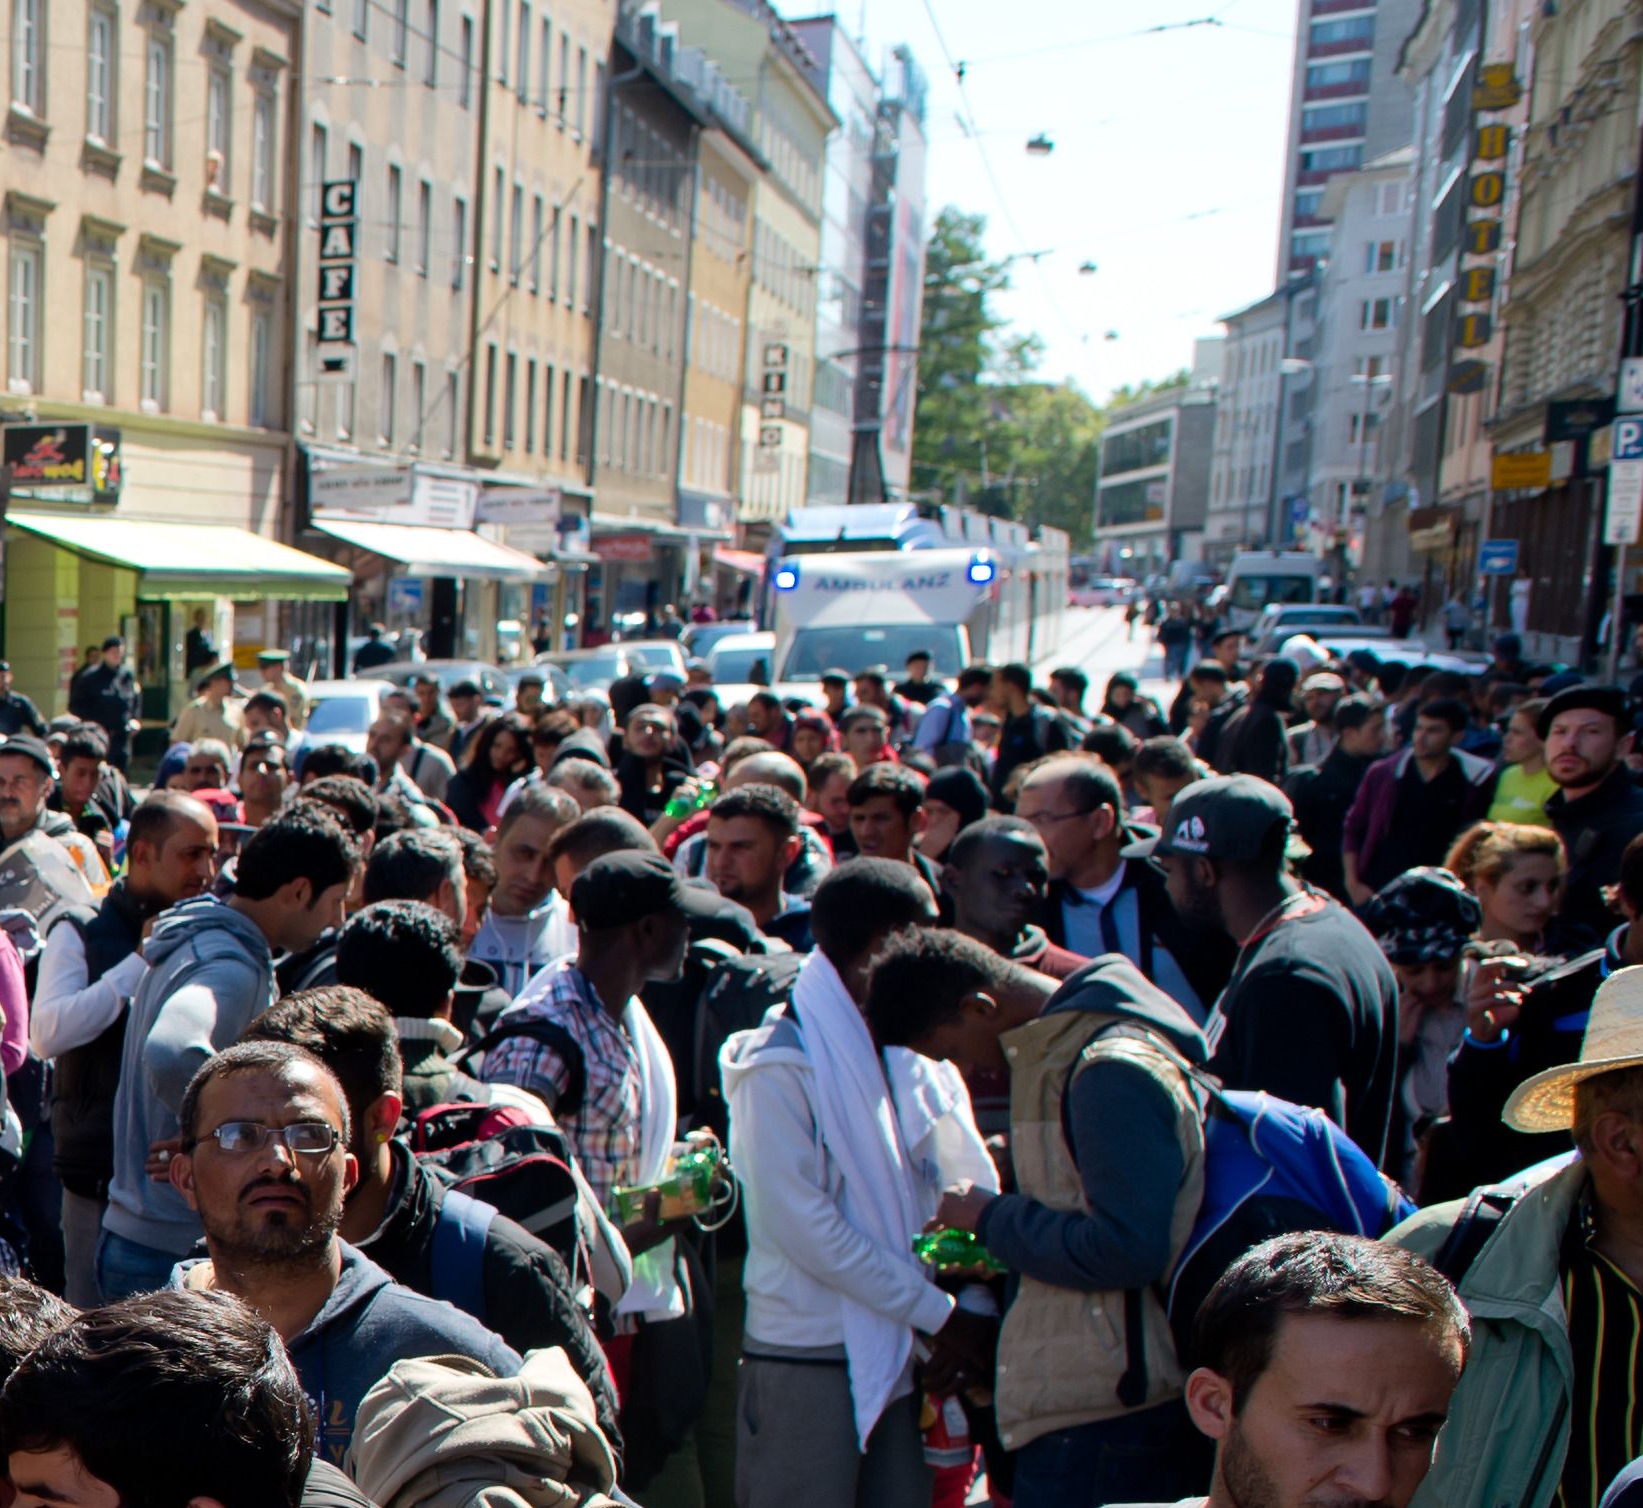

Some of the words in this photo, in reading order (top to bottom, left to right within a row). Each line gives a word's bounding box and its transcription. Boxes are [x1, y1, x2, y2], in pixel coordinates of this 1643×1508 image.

[320, 181, 355, 342] CAFE
[1460, 122, 1511, 349] HOTEL
[760, 344, 788, 446] KINO
[812, 570, 952, 593] AMBULANZ
